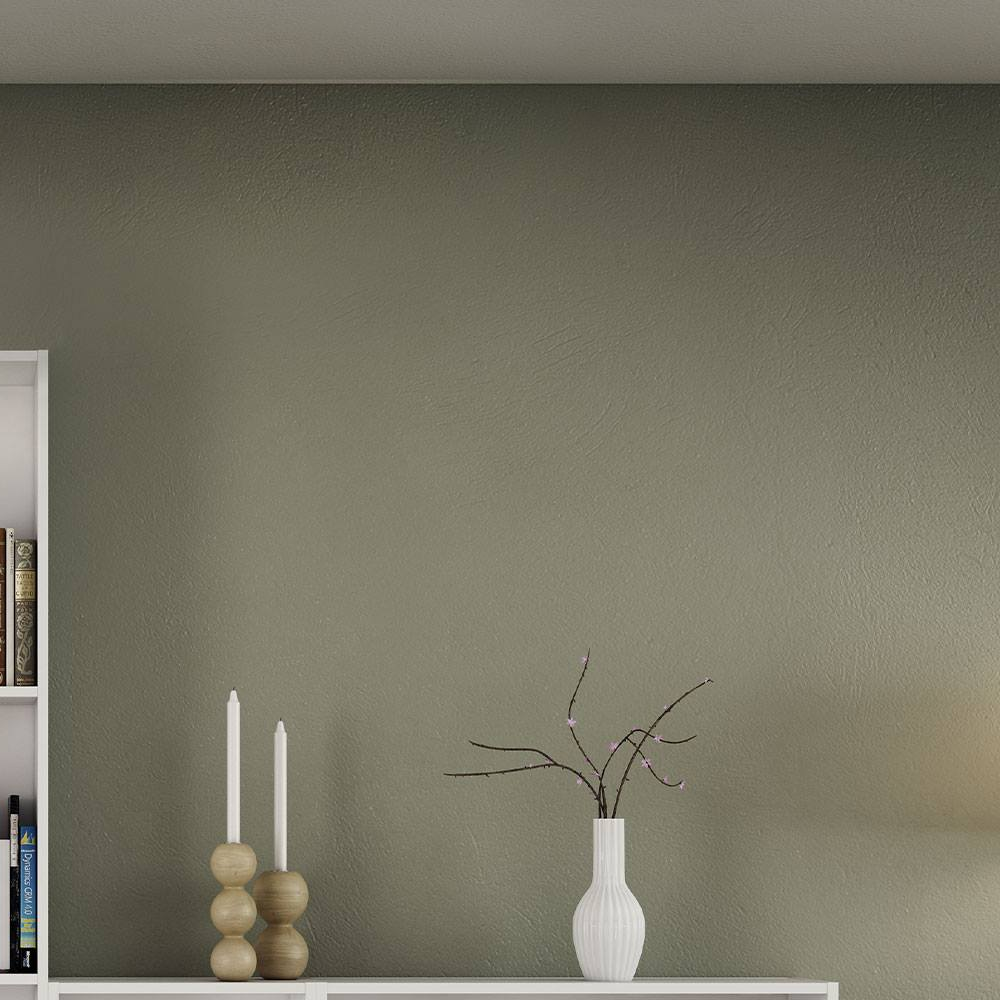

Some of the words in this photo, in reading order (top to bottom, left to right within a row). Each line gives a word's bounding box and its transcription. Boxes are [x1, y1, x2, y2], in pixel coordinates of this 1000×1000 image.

[23, 853, 33, 885] Dynamics
[24, 887, 33, 903] CRM
[24, 904, 33, 915] 4.0
